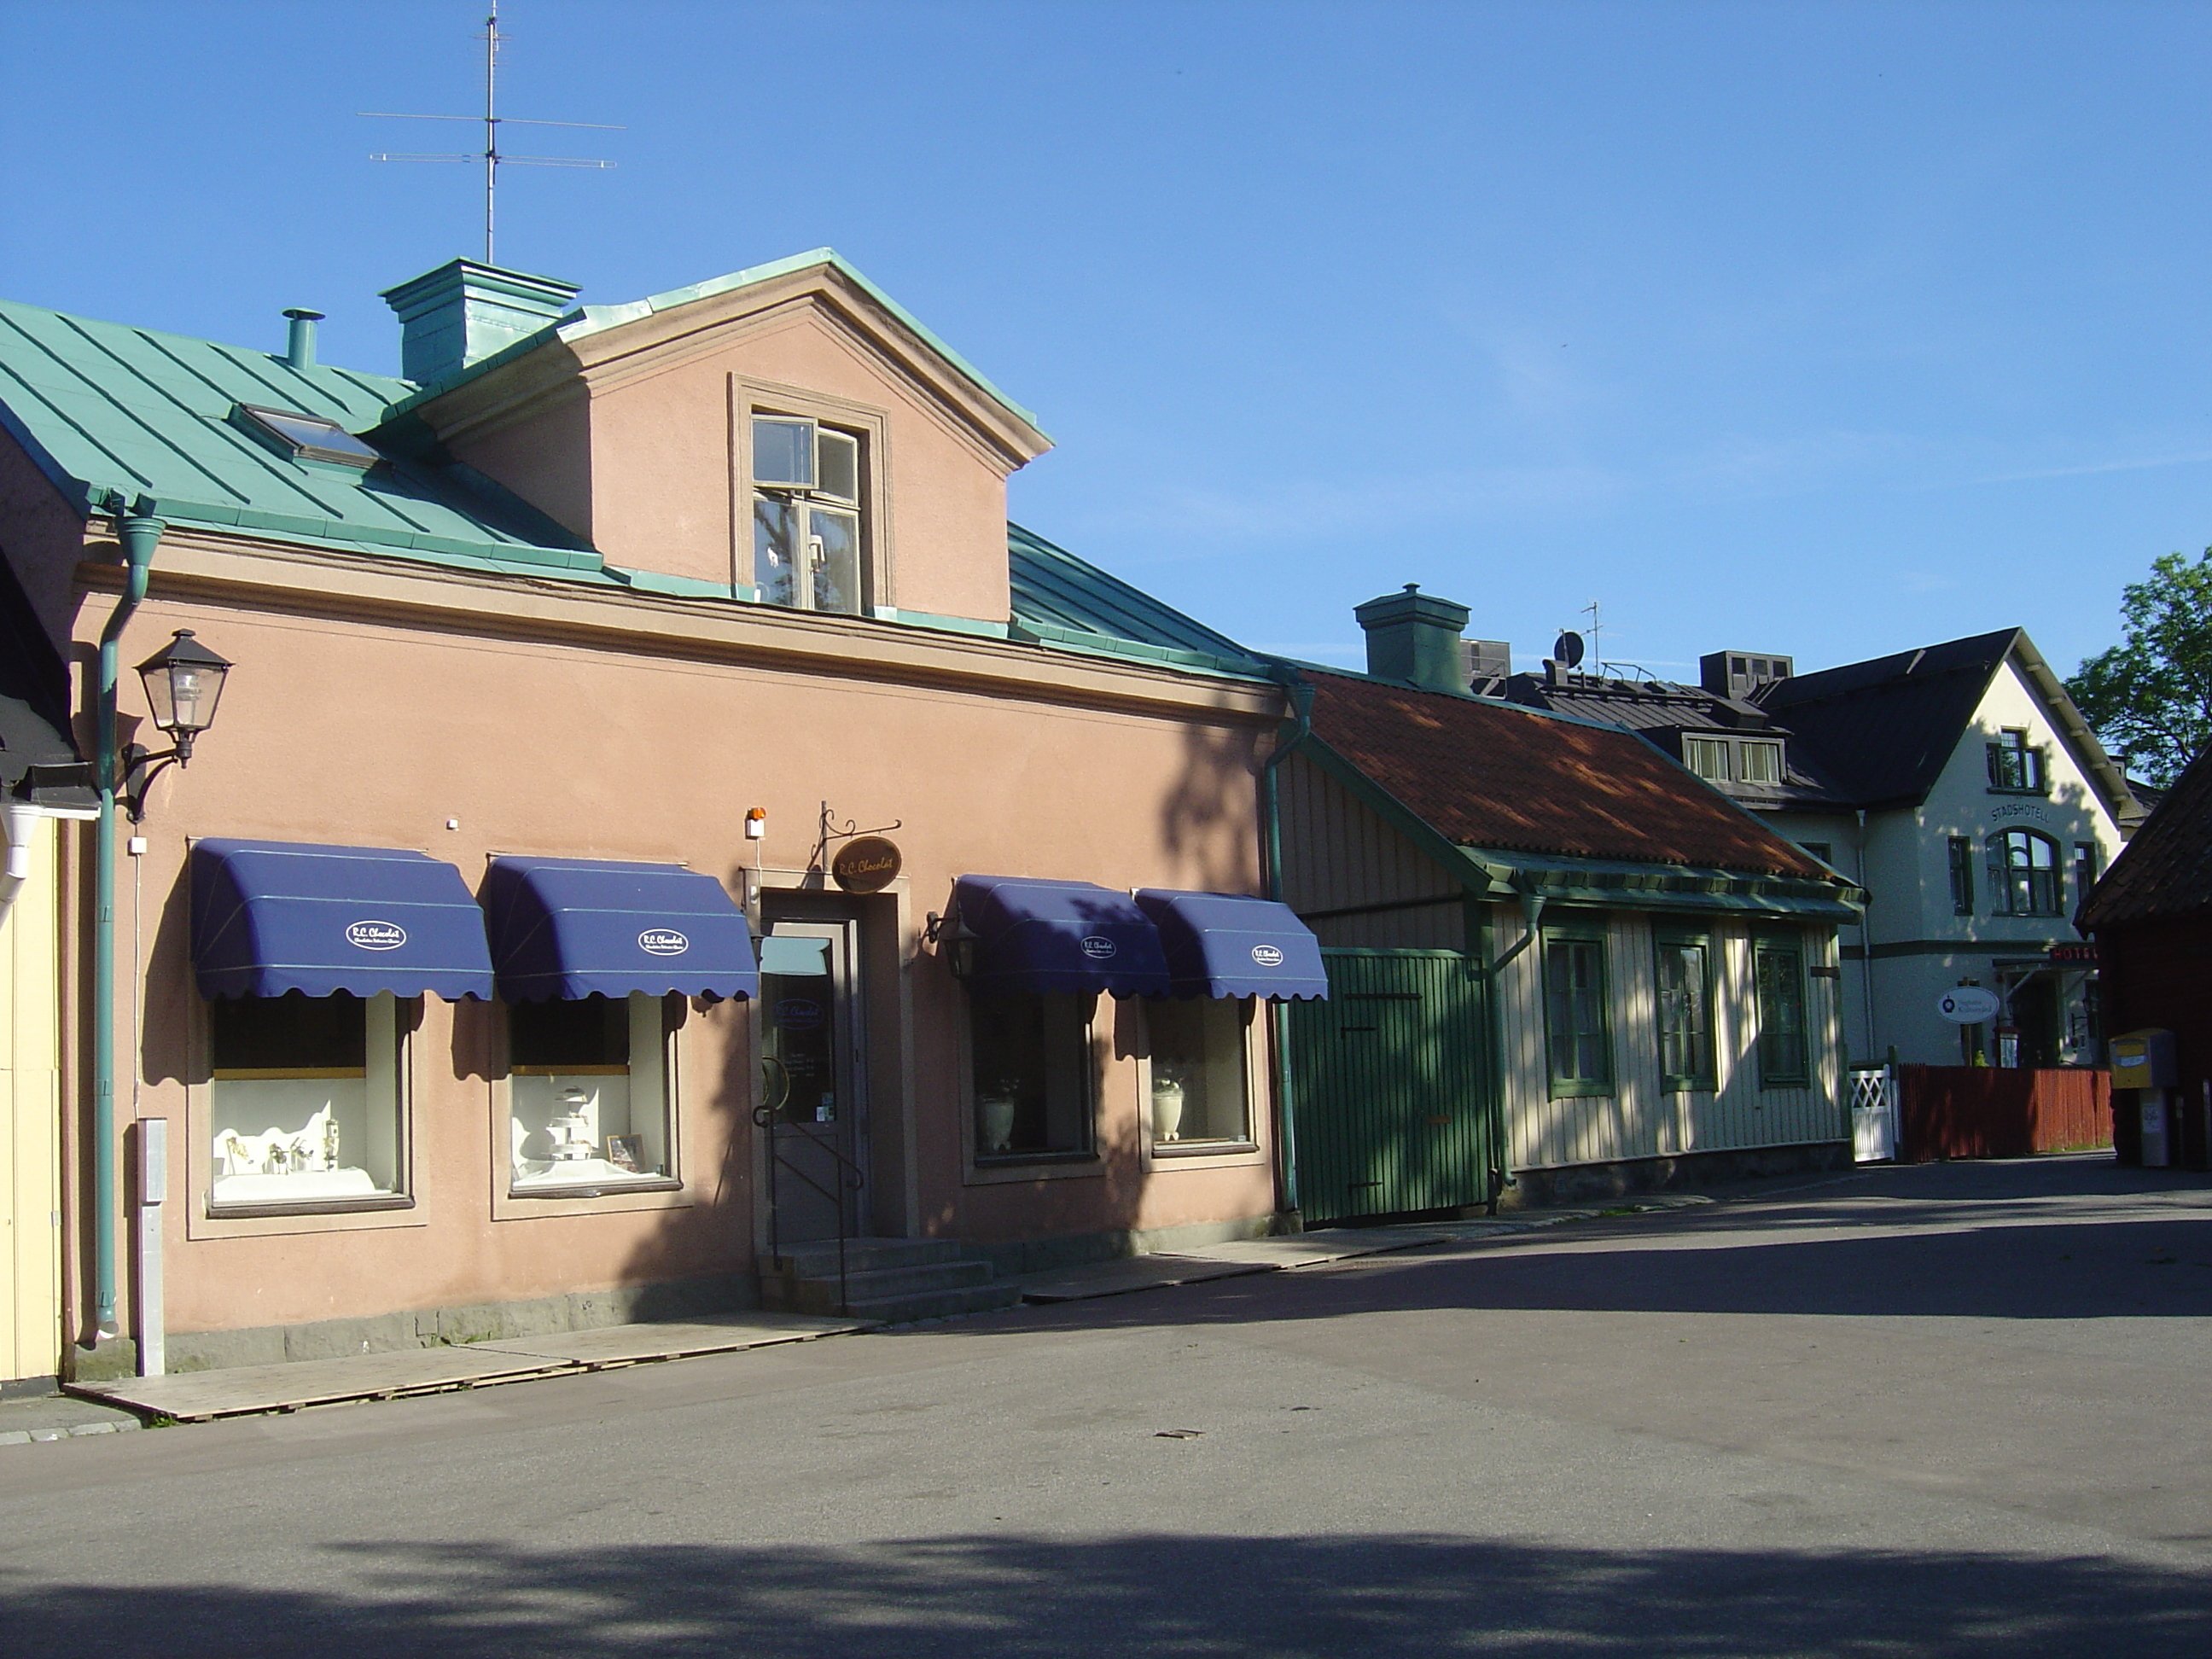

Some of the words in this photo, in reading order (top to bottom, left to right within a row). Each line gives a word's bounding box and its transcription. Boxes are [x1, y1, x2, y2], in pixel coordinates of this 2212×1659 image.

[1991, 804, 2050, 823] STADSHOTELL
[858, 857, 893, 873] Chocolat
[2053, 947, 2099, 959] HOTEL
